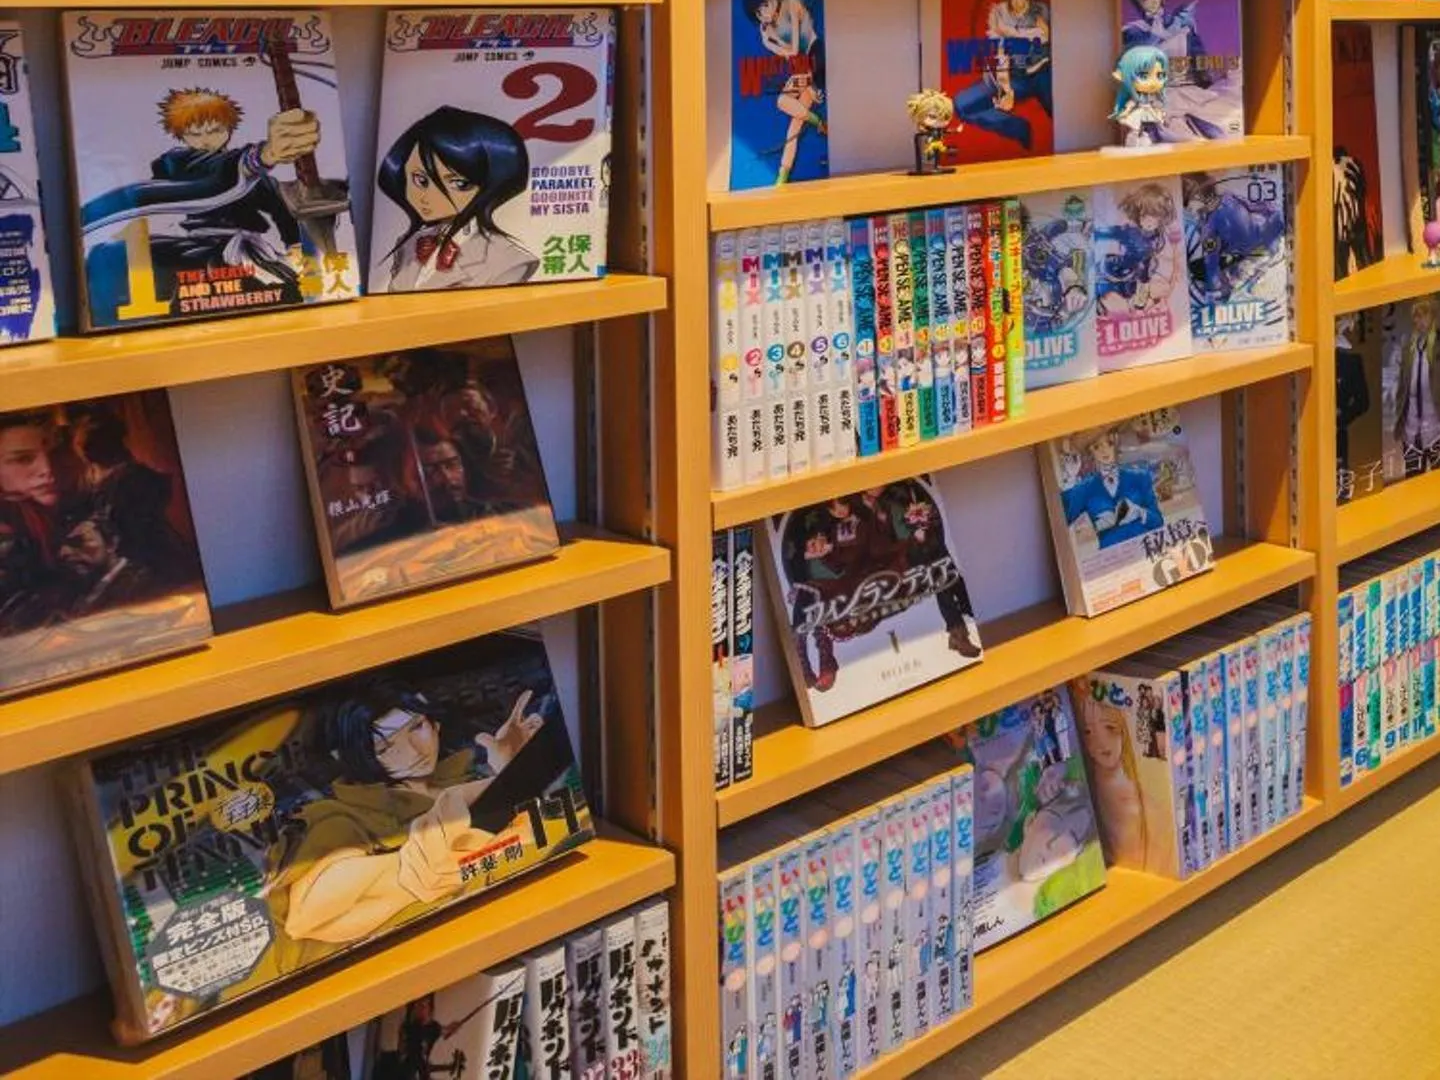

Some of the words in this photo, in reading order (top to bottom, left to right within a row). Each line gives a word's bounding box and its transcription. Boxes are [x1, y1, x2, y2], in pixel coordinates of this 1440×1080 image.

[501, 61, 598, 143] 2
[529, 203, 552, 217] MY
[552, 201, 590, 216] SISTA
[1247, 181, 1278, 204] 03
[112, 216, 172, 321] 1
[178, 282, 211, 300] AND
[213, 279, 243, 295] THE
[742, 255, 762, 306] MIX
[763, 252, 783, 302] MIX
[783, 250, 803, 300] MIX
[805, 246, 826, 295] MIX
[827, 242, 847, 292] MIX
[180, 288, 283, 313] STRAWBERRY
[320, 364, 363, 437] 史記
